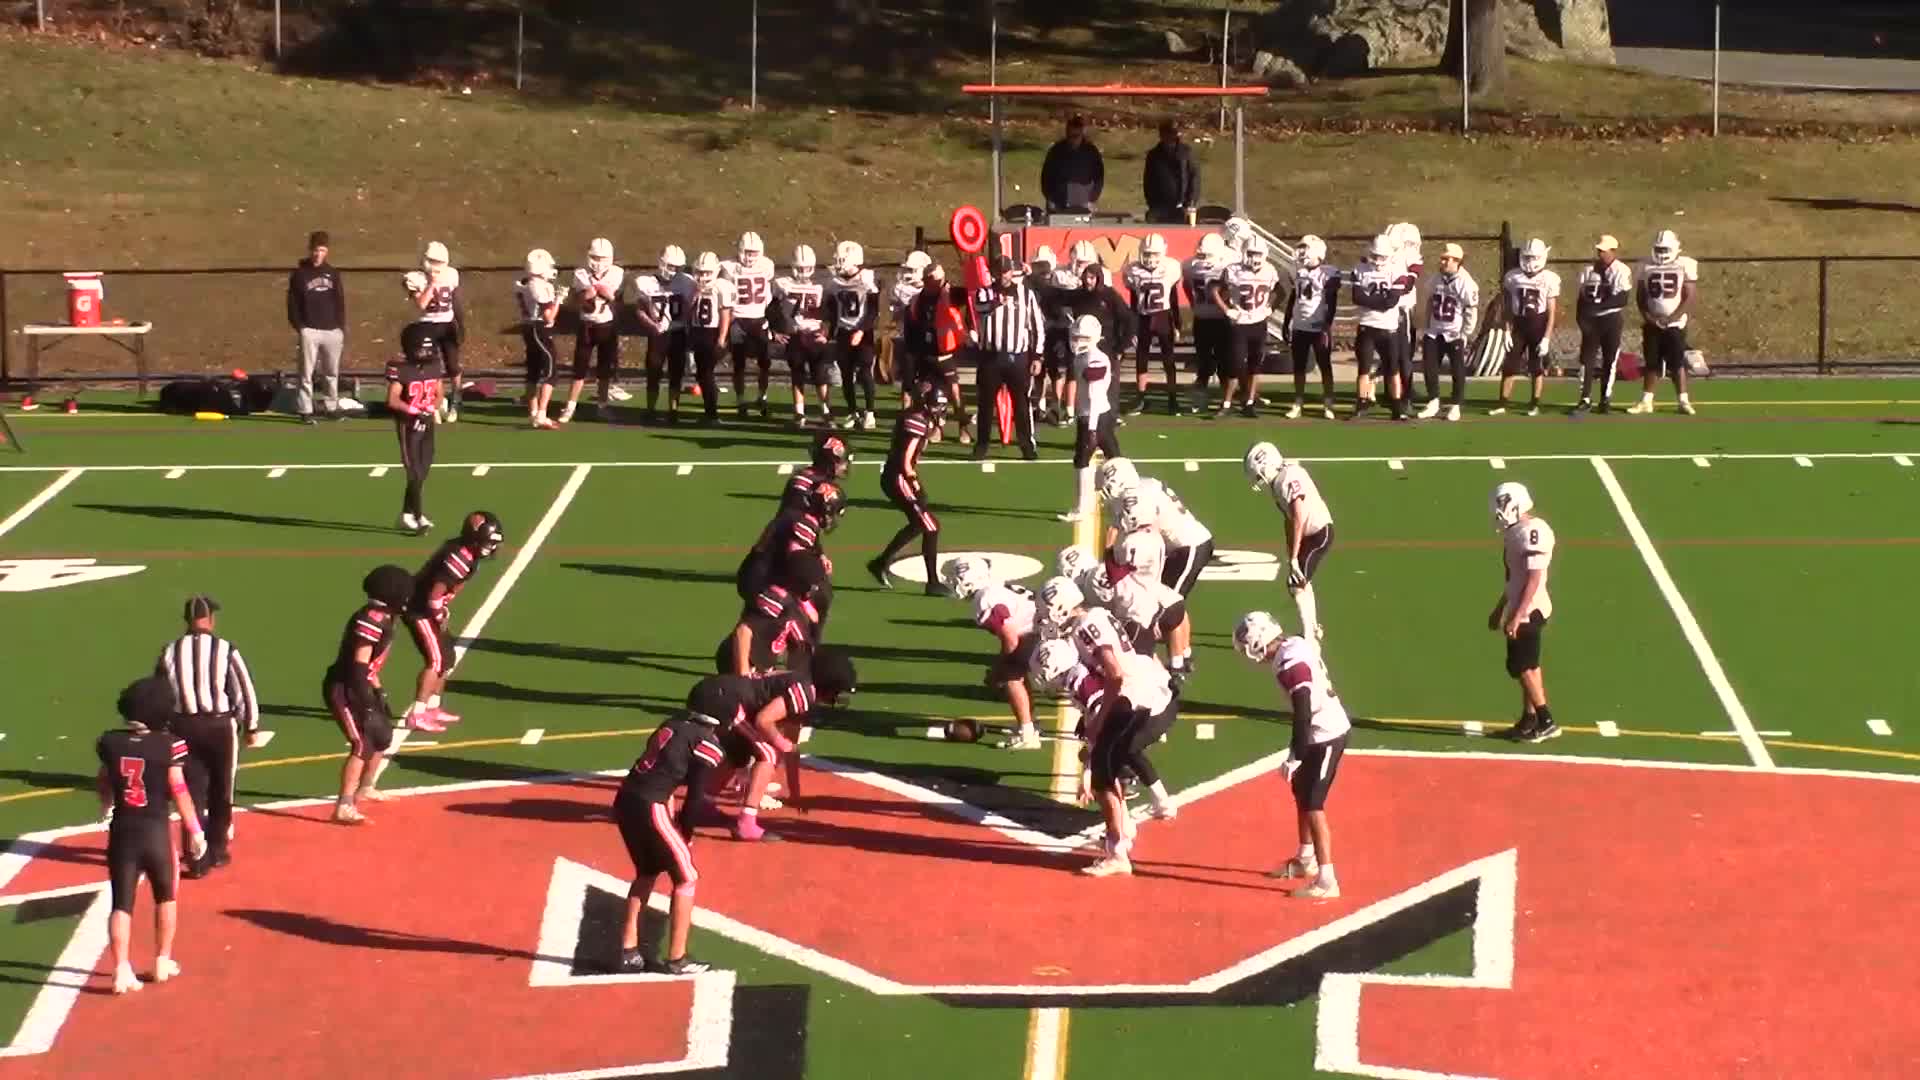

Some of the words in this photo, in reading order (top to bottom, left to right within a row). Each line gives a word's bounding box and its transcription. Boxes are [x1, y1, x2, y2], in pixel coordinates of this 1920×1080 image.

[738, 277, 766, 306] 32
[1530, 530, 1538, 545] 8
[120, 756, 148, 807] 3
